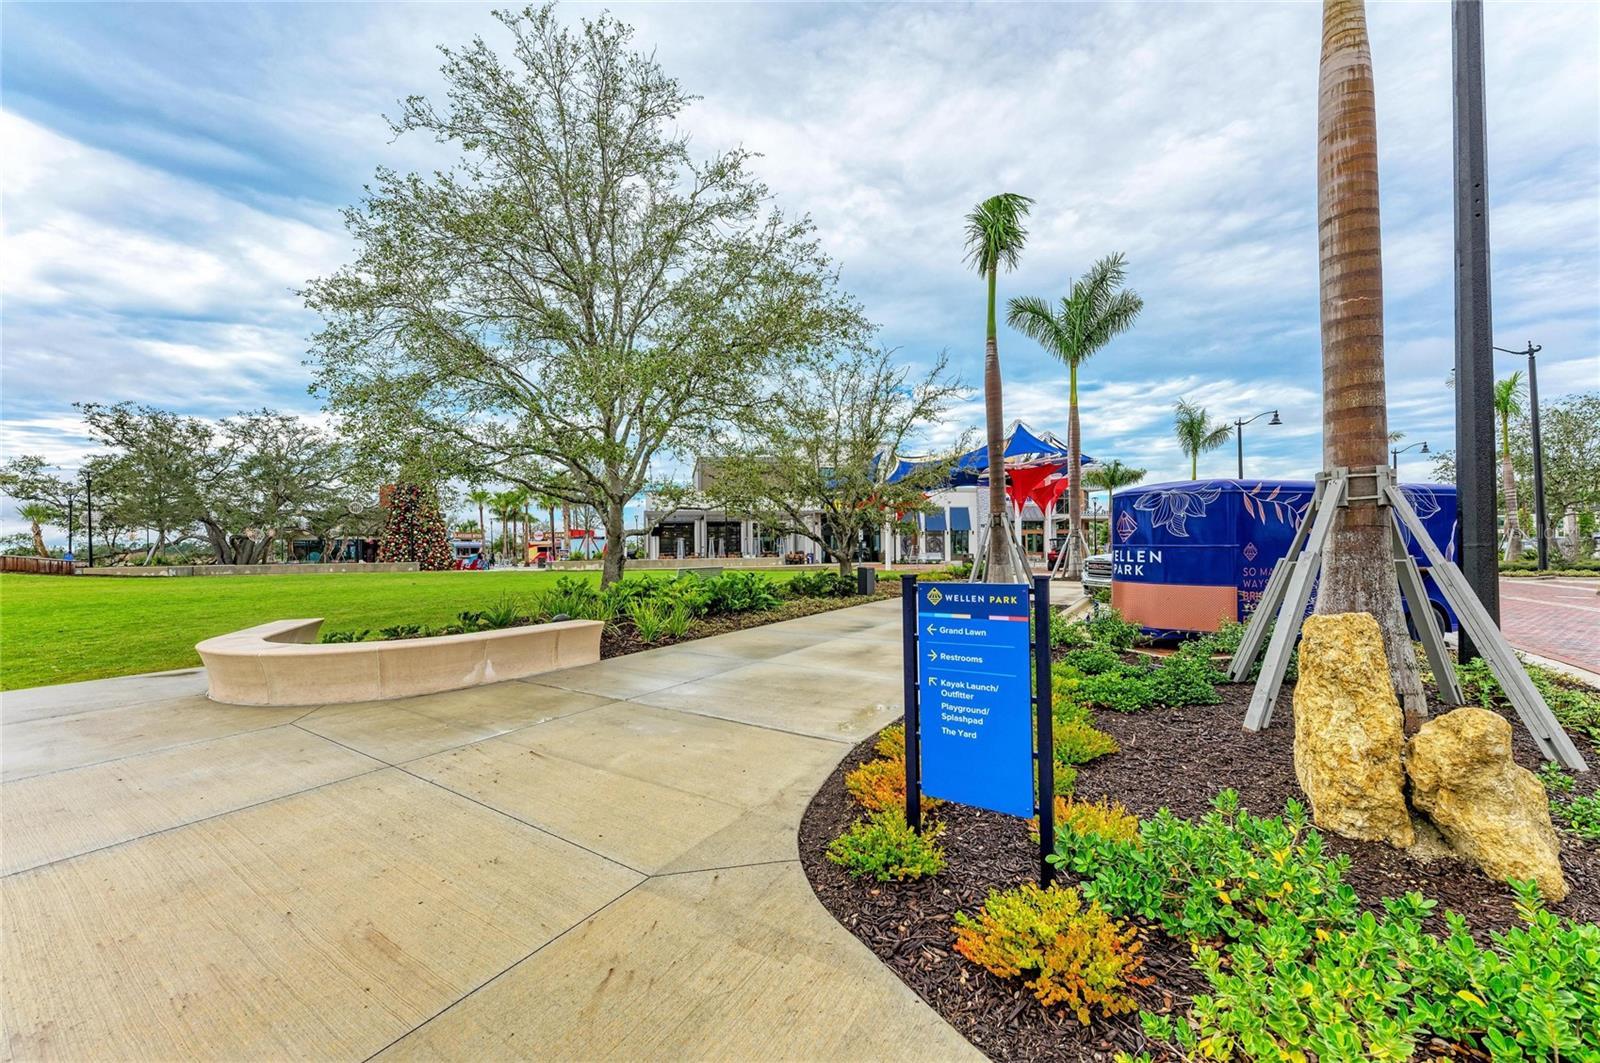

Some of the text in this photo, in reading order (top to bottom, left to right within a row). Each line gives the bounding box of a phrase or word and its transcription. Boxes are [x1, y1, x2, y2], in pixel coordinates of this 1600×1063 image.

[1113, 550, 1162, 563] ELLEN
[1113, 564, 1144, 576] PARK
[1242, 567, 1274, 577] SO MA
[945, 594, 1018, 604] WELLEN PARK
[939, 626, 987, 637] Grand Lawn
[940, 652, 983, 664] Restrooms
[940, 679, 999, 693] Kayak Launch/
[940, 689, 974, 700] Outfitter
[941, 702, 990, 716] Playground/
[941, 712, 984, 726] Splashpad
[941, 727, 977, 740] The Yard
